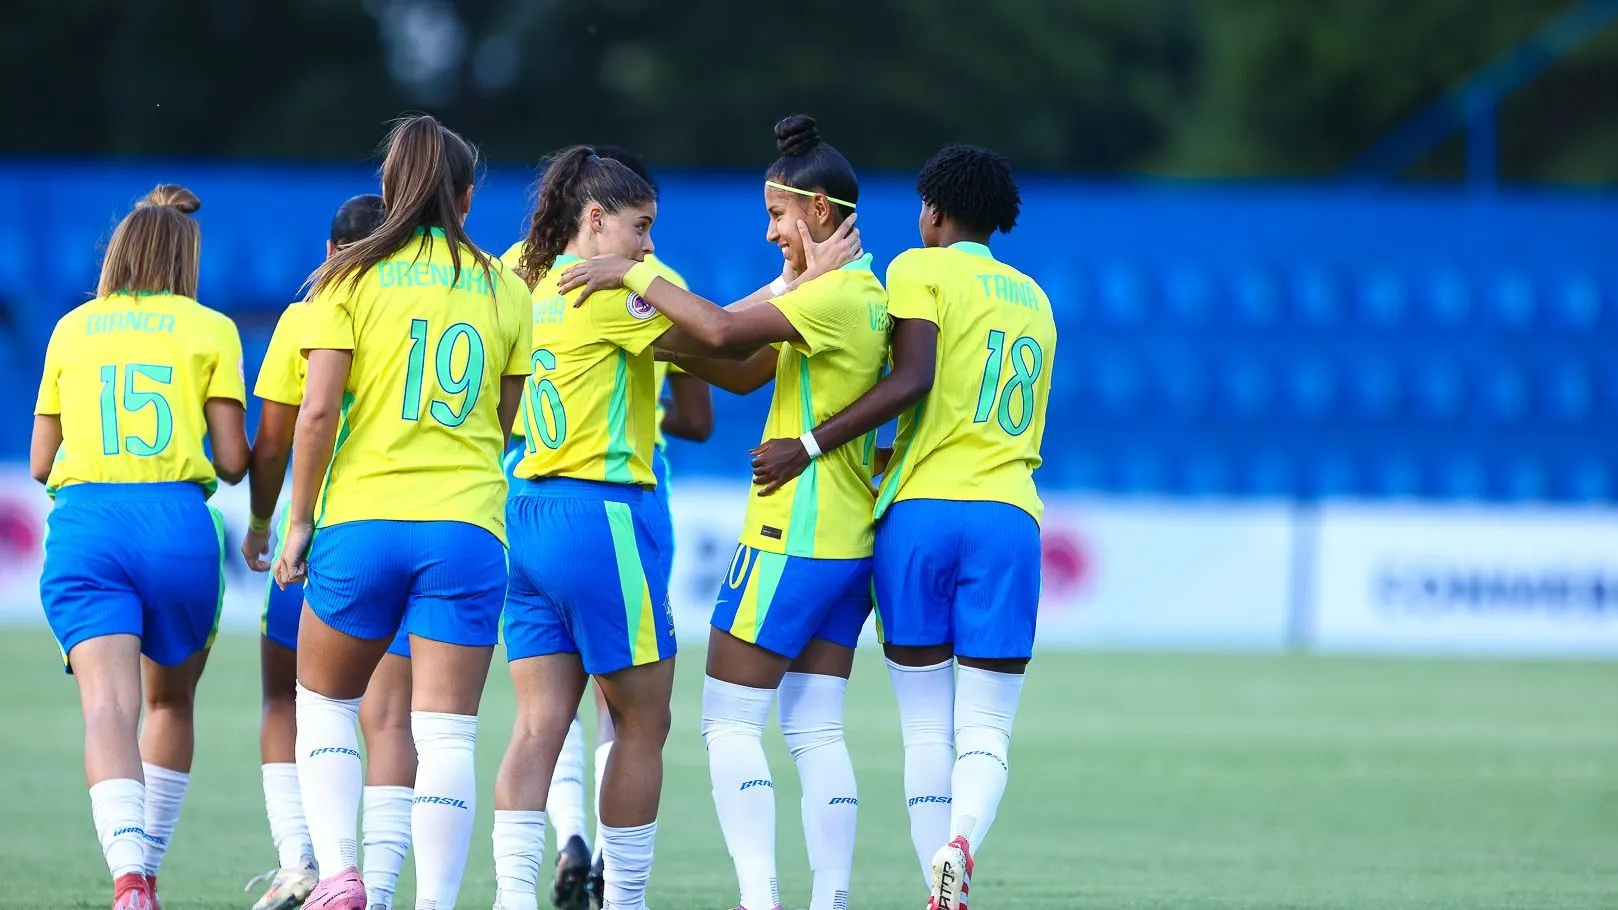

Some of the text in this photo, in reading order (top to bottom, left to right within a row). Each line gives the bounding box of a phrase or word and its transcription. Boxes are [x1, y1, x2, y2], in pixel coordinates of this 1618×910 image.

[86, 310, 176, 335] BIANCA
[378, 260, 498, 295] BRENDHA
[100, 363, 173, 457] 15
[402, 318, 485, 428] 19
[973, 329, 1043, 437] 18
